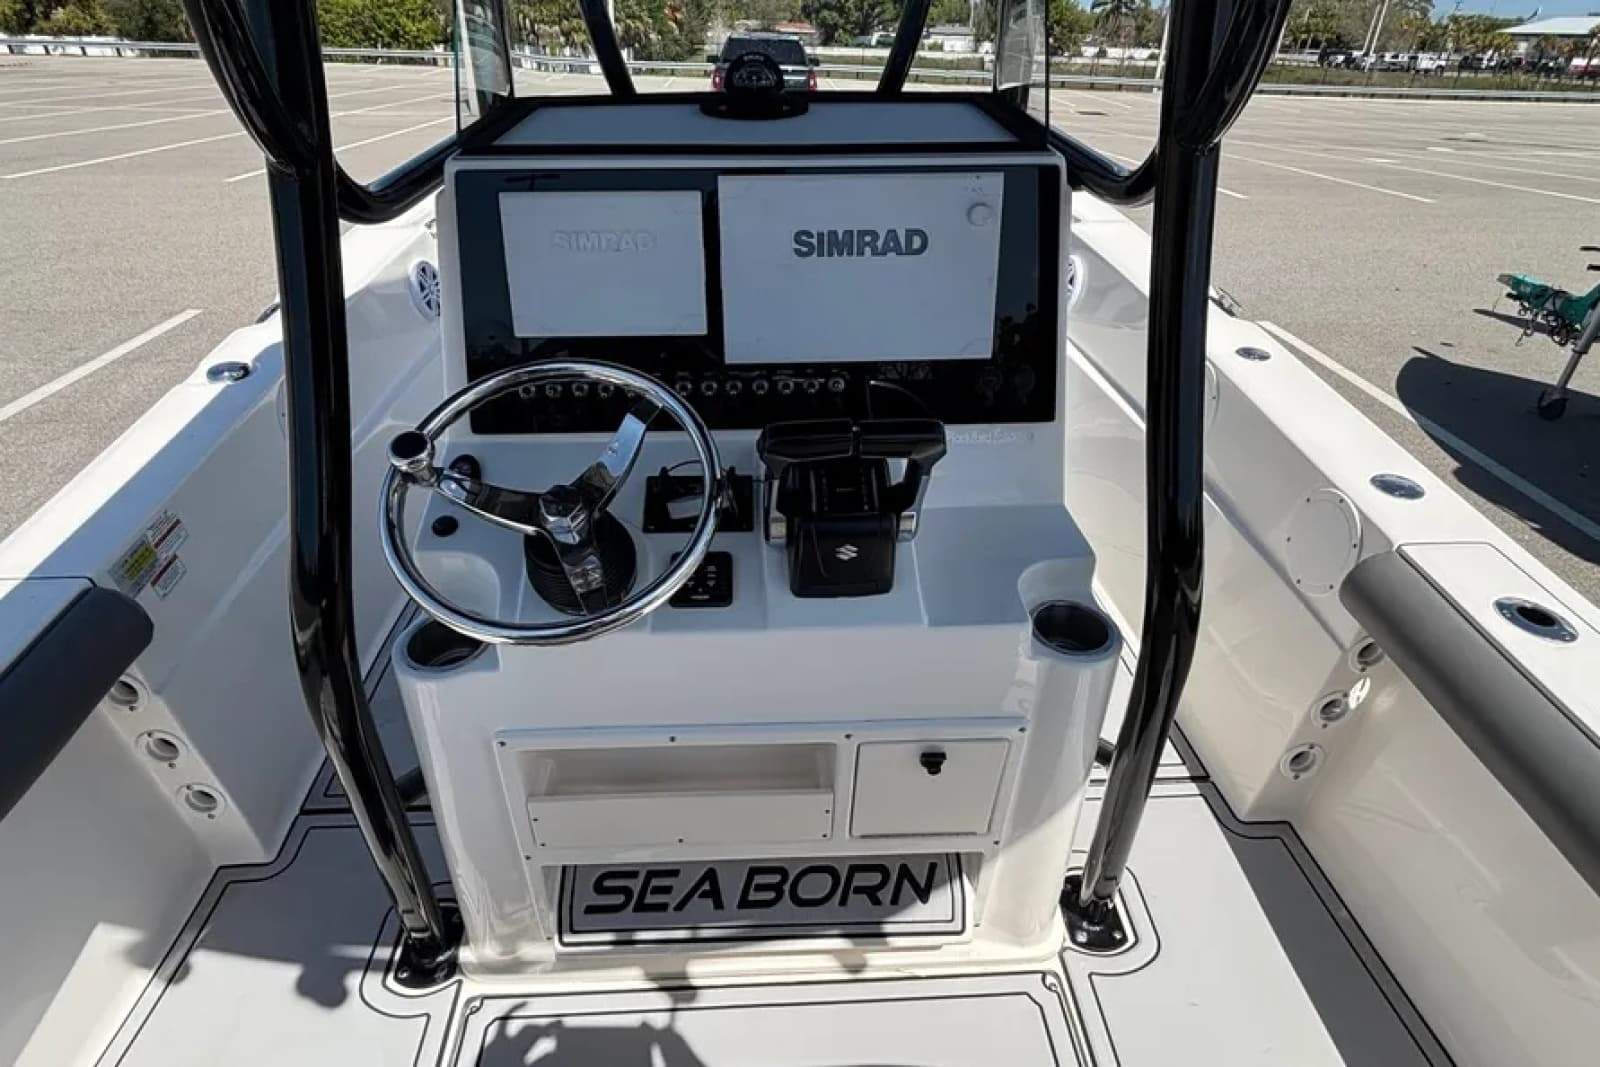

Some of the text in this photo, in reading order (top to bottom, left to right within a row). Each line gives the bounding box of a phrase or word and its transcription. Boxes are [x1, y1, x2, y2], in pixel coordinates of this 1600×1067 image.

[793, 229, 929, 258] SIMRAD
[583, 862, 938, 915] SEA BORN
